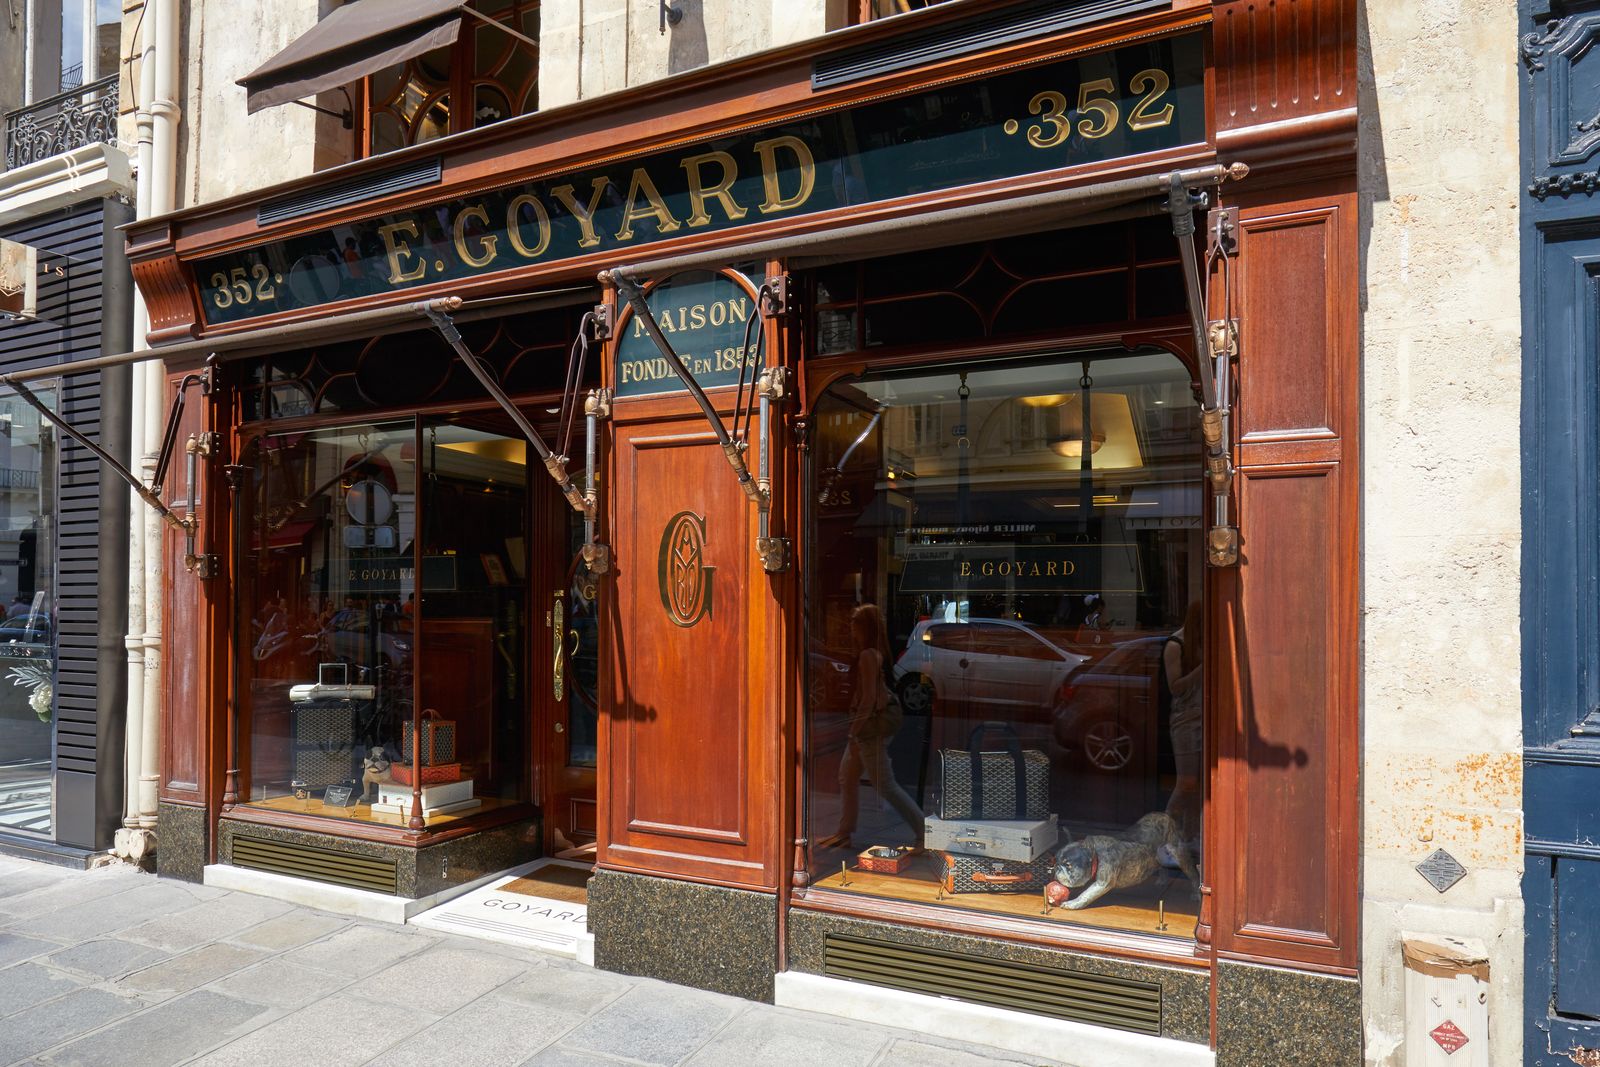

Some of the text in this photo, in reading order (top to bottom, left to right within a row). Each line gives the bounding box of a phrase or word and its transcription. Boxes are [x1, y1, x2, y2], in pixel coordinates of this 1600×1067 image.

[694, 358, 712, 375] EN
[982, 560, 1075, 577] GOYARD
[483, 898, 588, 924] GOYARD
[1442, 1023, 1456, 1031] GAZ
